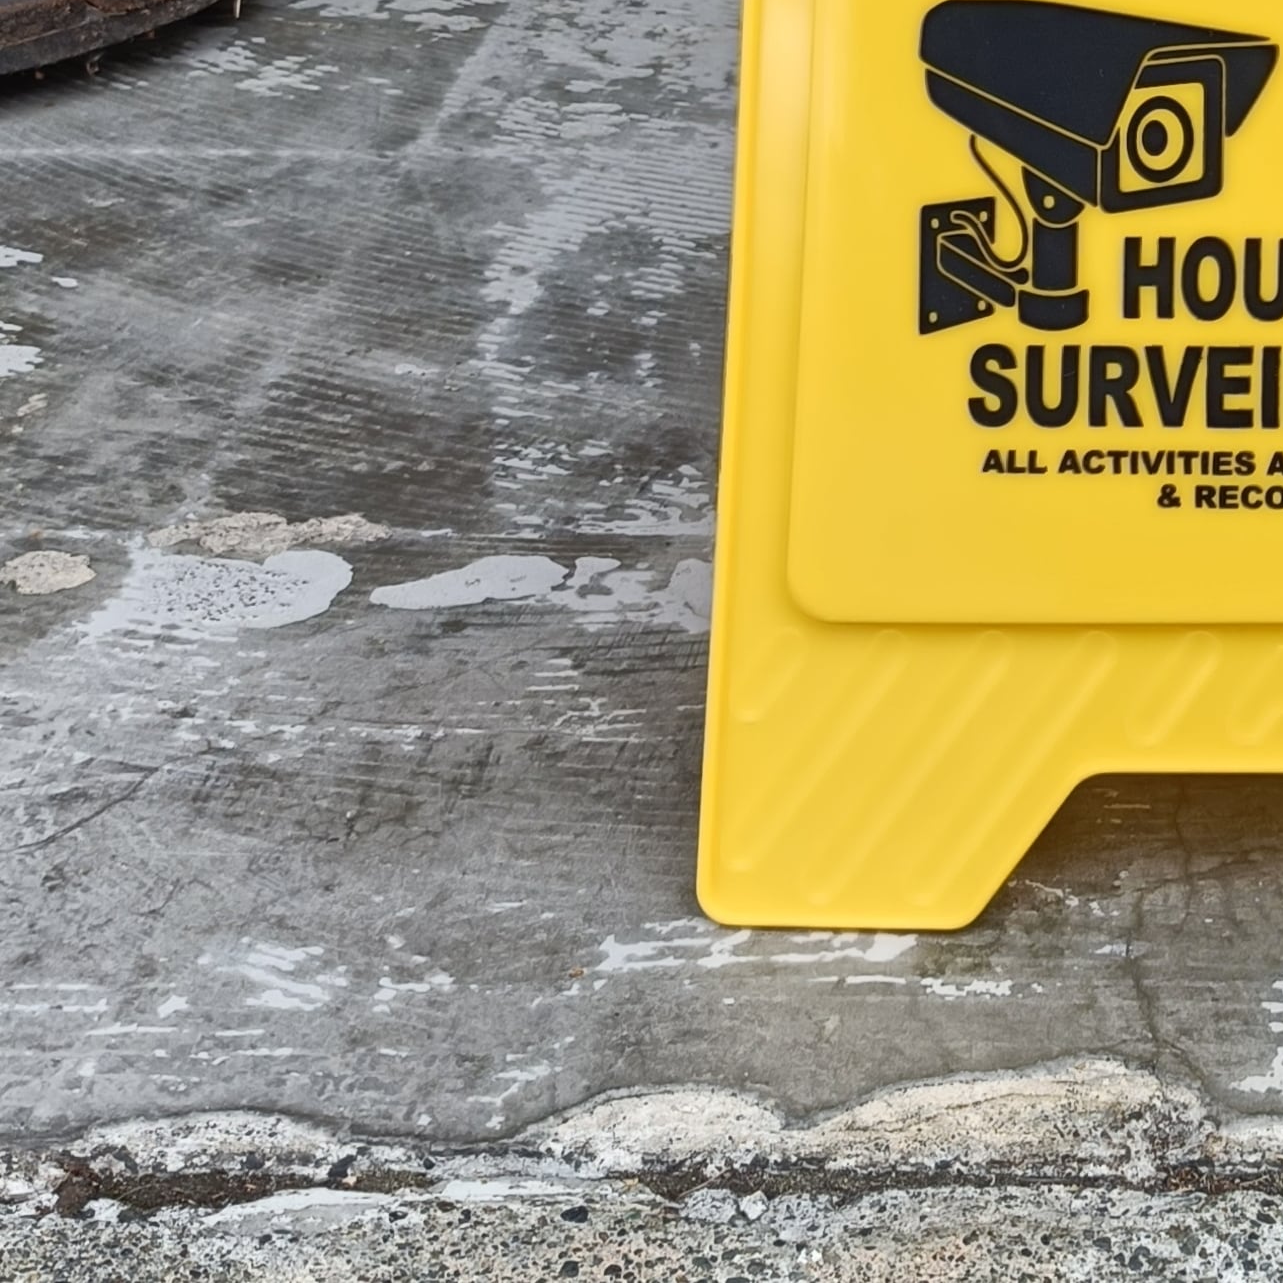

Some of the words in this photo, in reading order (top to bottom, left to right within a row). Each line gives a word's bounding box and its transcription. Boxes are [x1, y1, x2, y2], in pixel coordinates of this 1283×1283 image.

[982, 450, 1048, 475] ALL
[1058, 450, 1256, 476] ACTIVITIES
[1157, 485, 1181, 509] &
